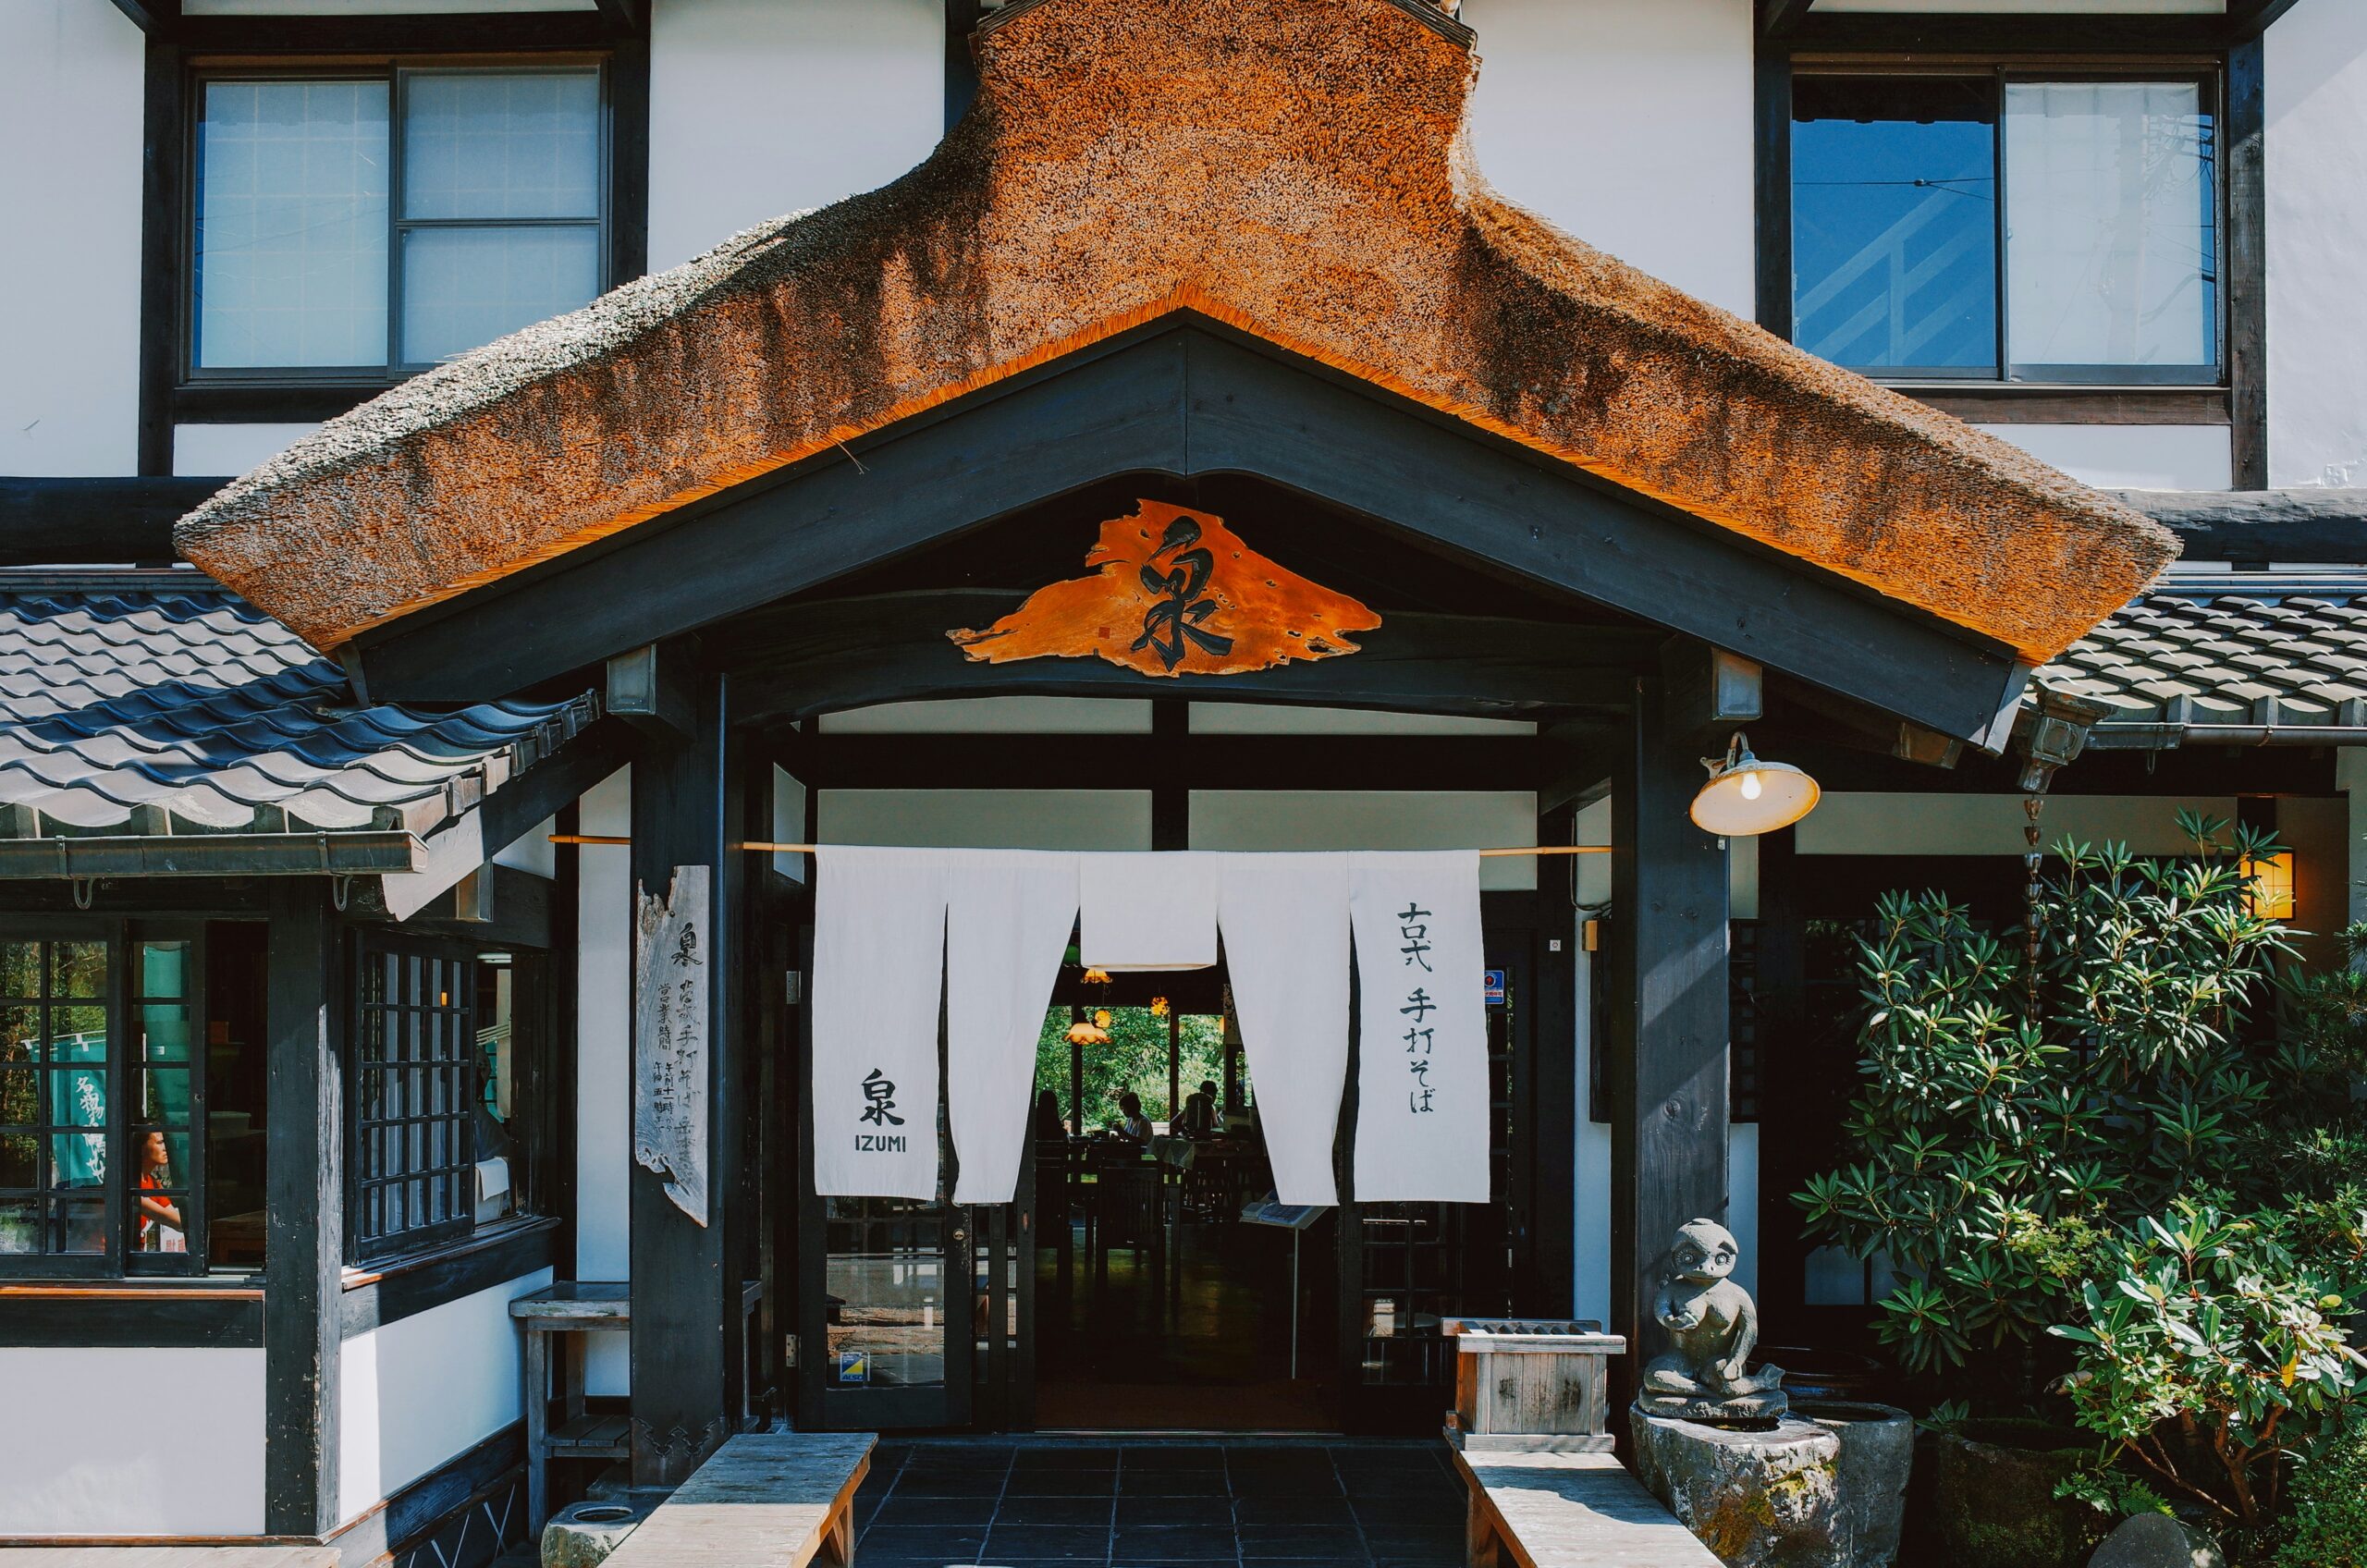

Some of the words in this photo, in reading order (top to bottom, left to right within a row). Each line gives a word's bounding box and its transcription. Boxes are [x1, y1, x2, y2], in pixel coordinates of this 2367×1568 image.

[670, 922, 704, 967] 泉
[859, 1068, 905, 1126] 泉
[855, 1134, 906, 1152] IZUMI
